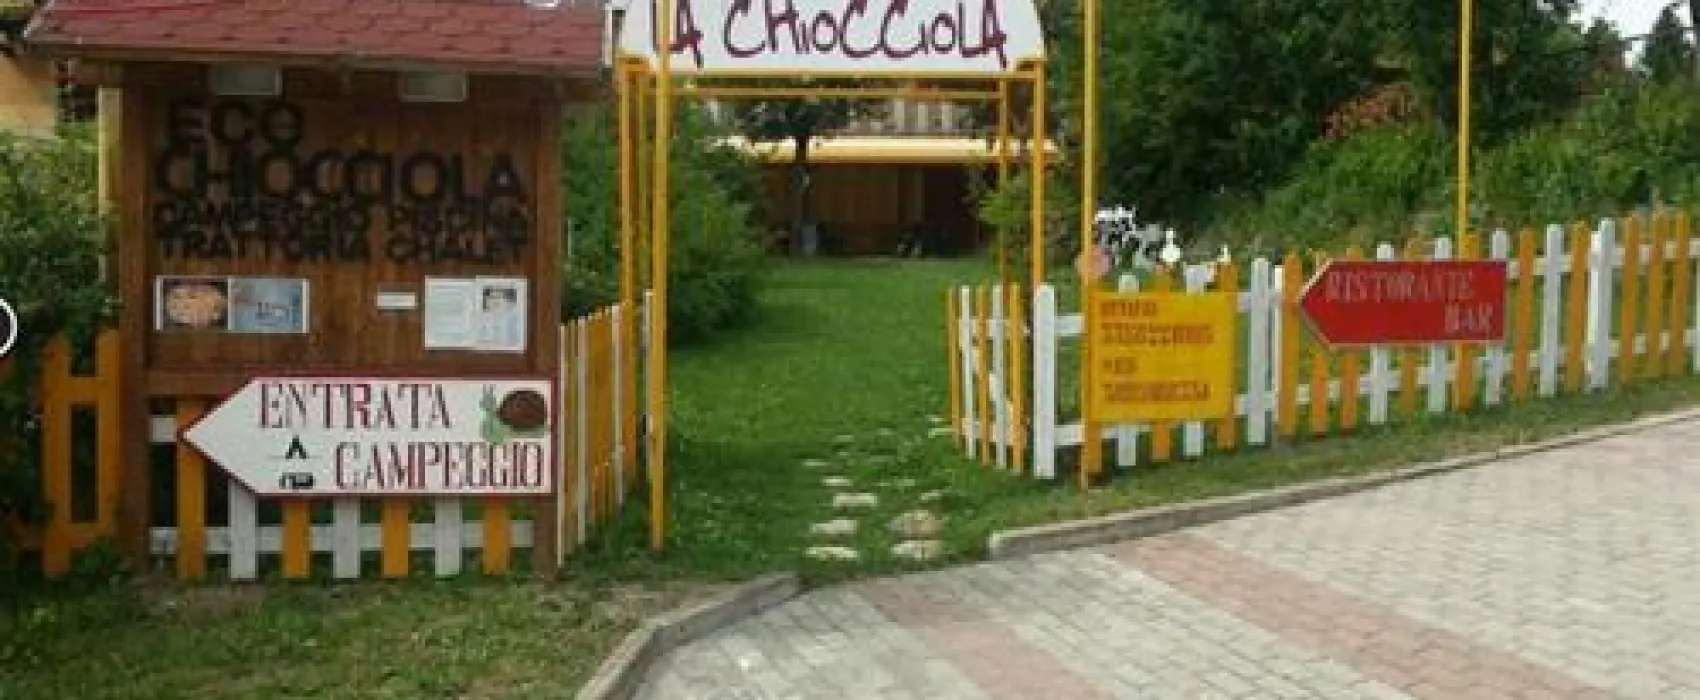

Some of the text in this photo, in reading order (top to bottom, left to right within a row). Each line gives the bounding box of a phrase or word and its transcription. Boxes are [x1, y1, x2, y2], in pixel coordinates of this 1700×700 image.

[168, 101, 303, 145] ECO
[157, 150, 527, 203] CHIOCCIOLA
[1444, 303, 1494, 333] BAR
[258, 382, 451, 430] ENTRATA
[334, 440, 544, 491] CAMPEGGIO
